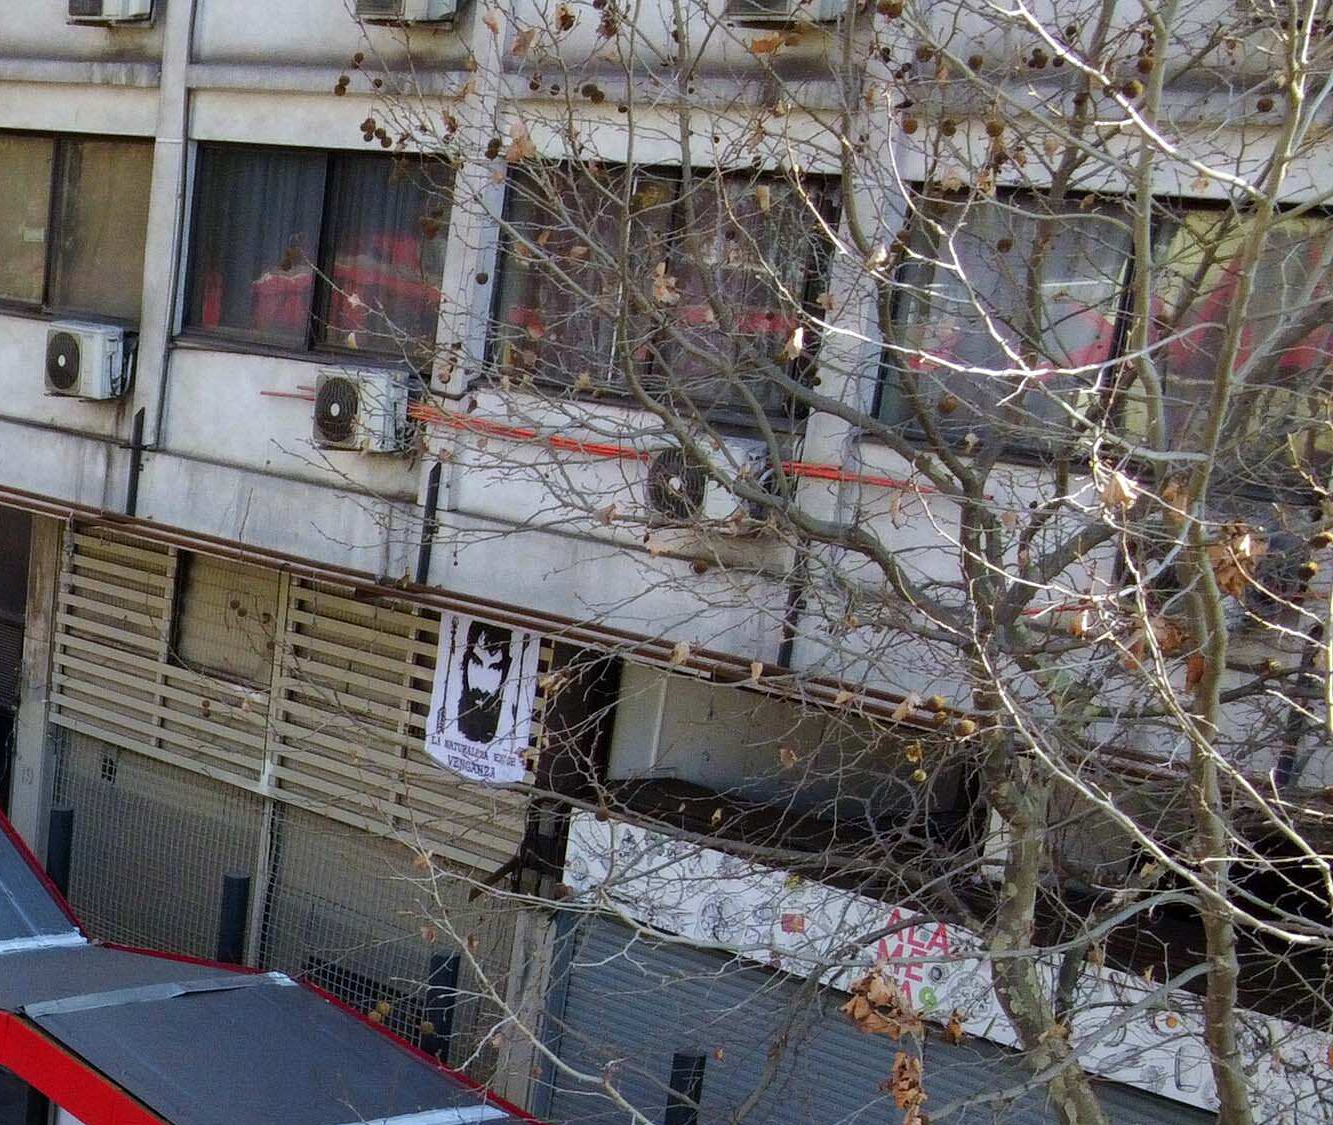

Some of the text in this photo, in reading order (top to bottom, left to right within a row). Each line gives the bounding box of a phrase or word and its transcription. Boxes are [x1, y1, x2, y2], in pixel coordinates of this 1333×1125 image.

[443, 740, 489, 760] NATURALEZA
[447, 754, 496, 778] VENGANZA
[886, 908, 951, 957] ALA
